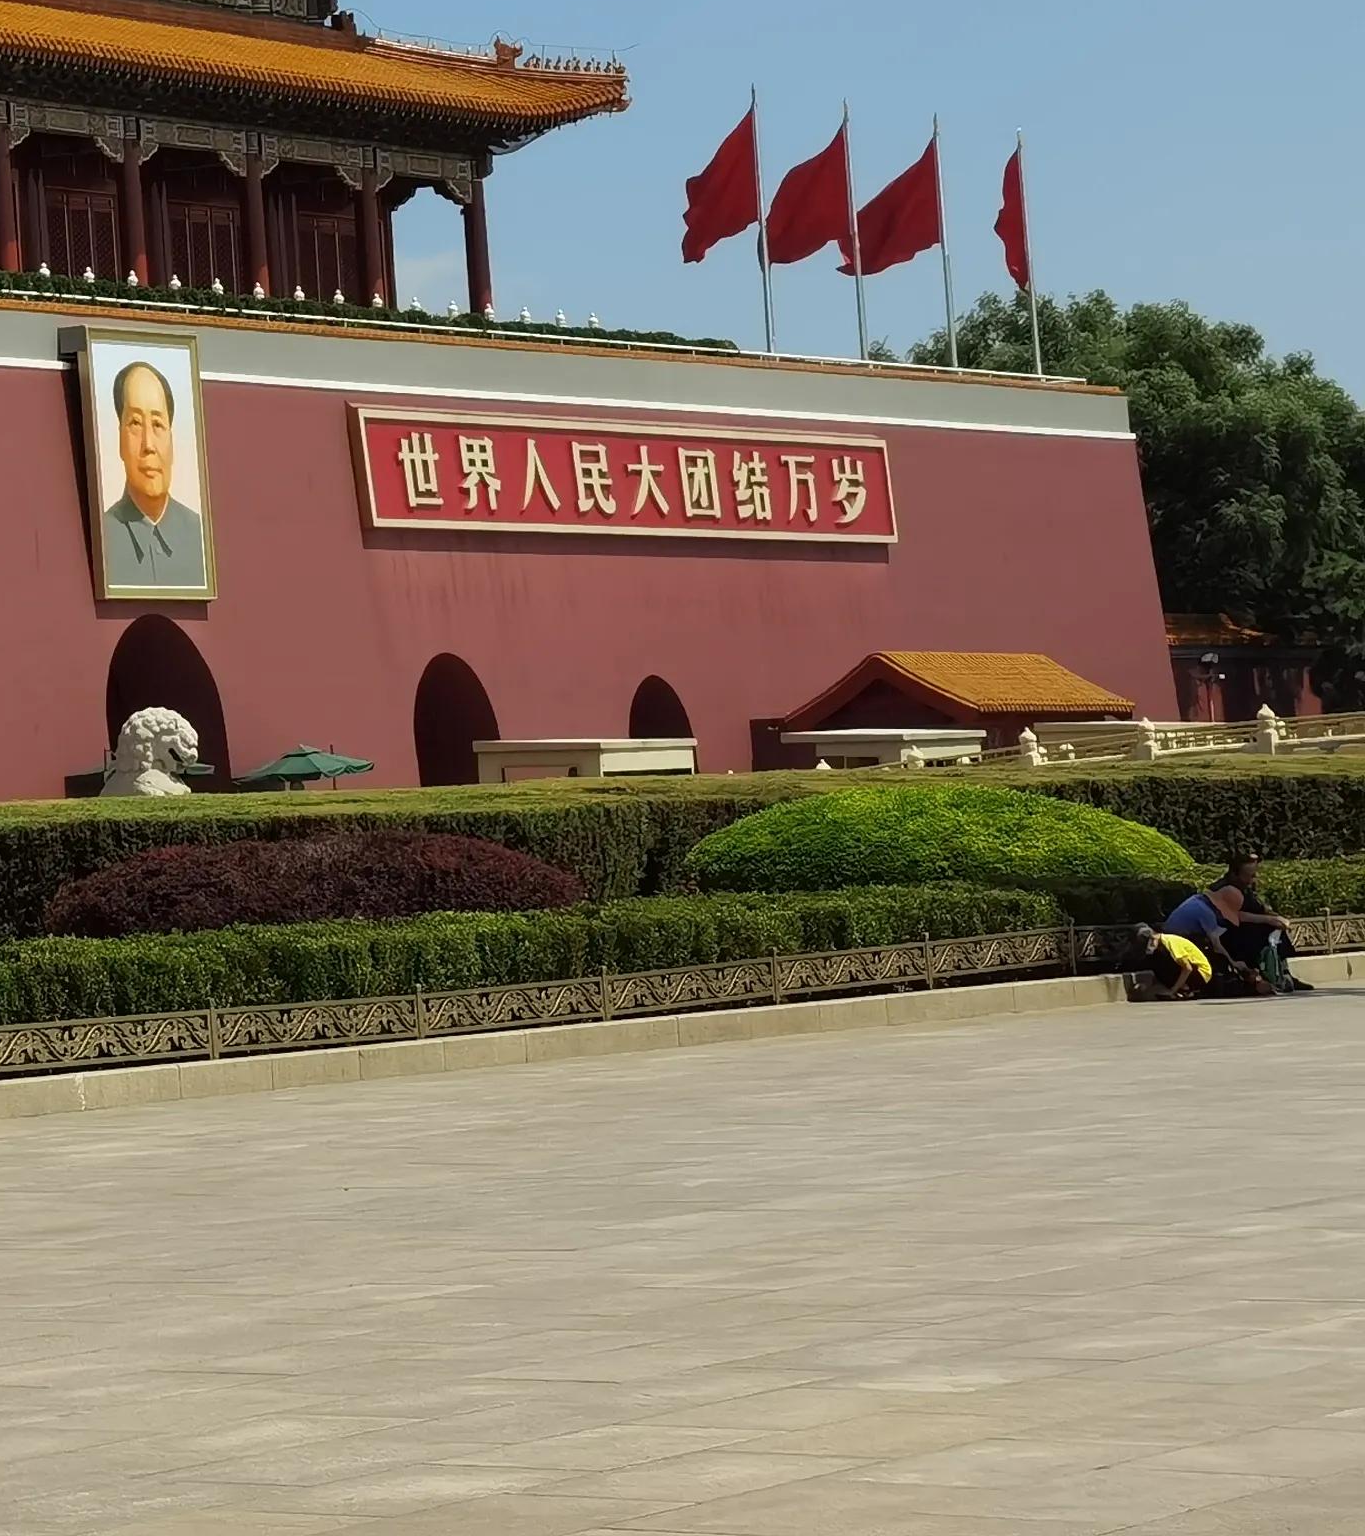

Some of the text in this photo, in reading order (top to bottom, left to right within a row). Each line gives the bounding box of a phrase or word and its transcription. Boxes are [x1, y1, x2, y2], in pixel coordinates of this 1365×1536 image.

[397, 431, 867, 524] 世界人民大团结万岁
